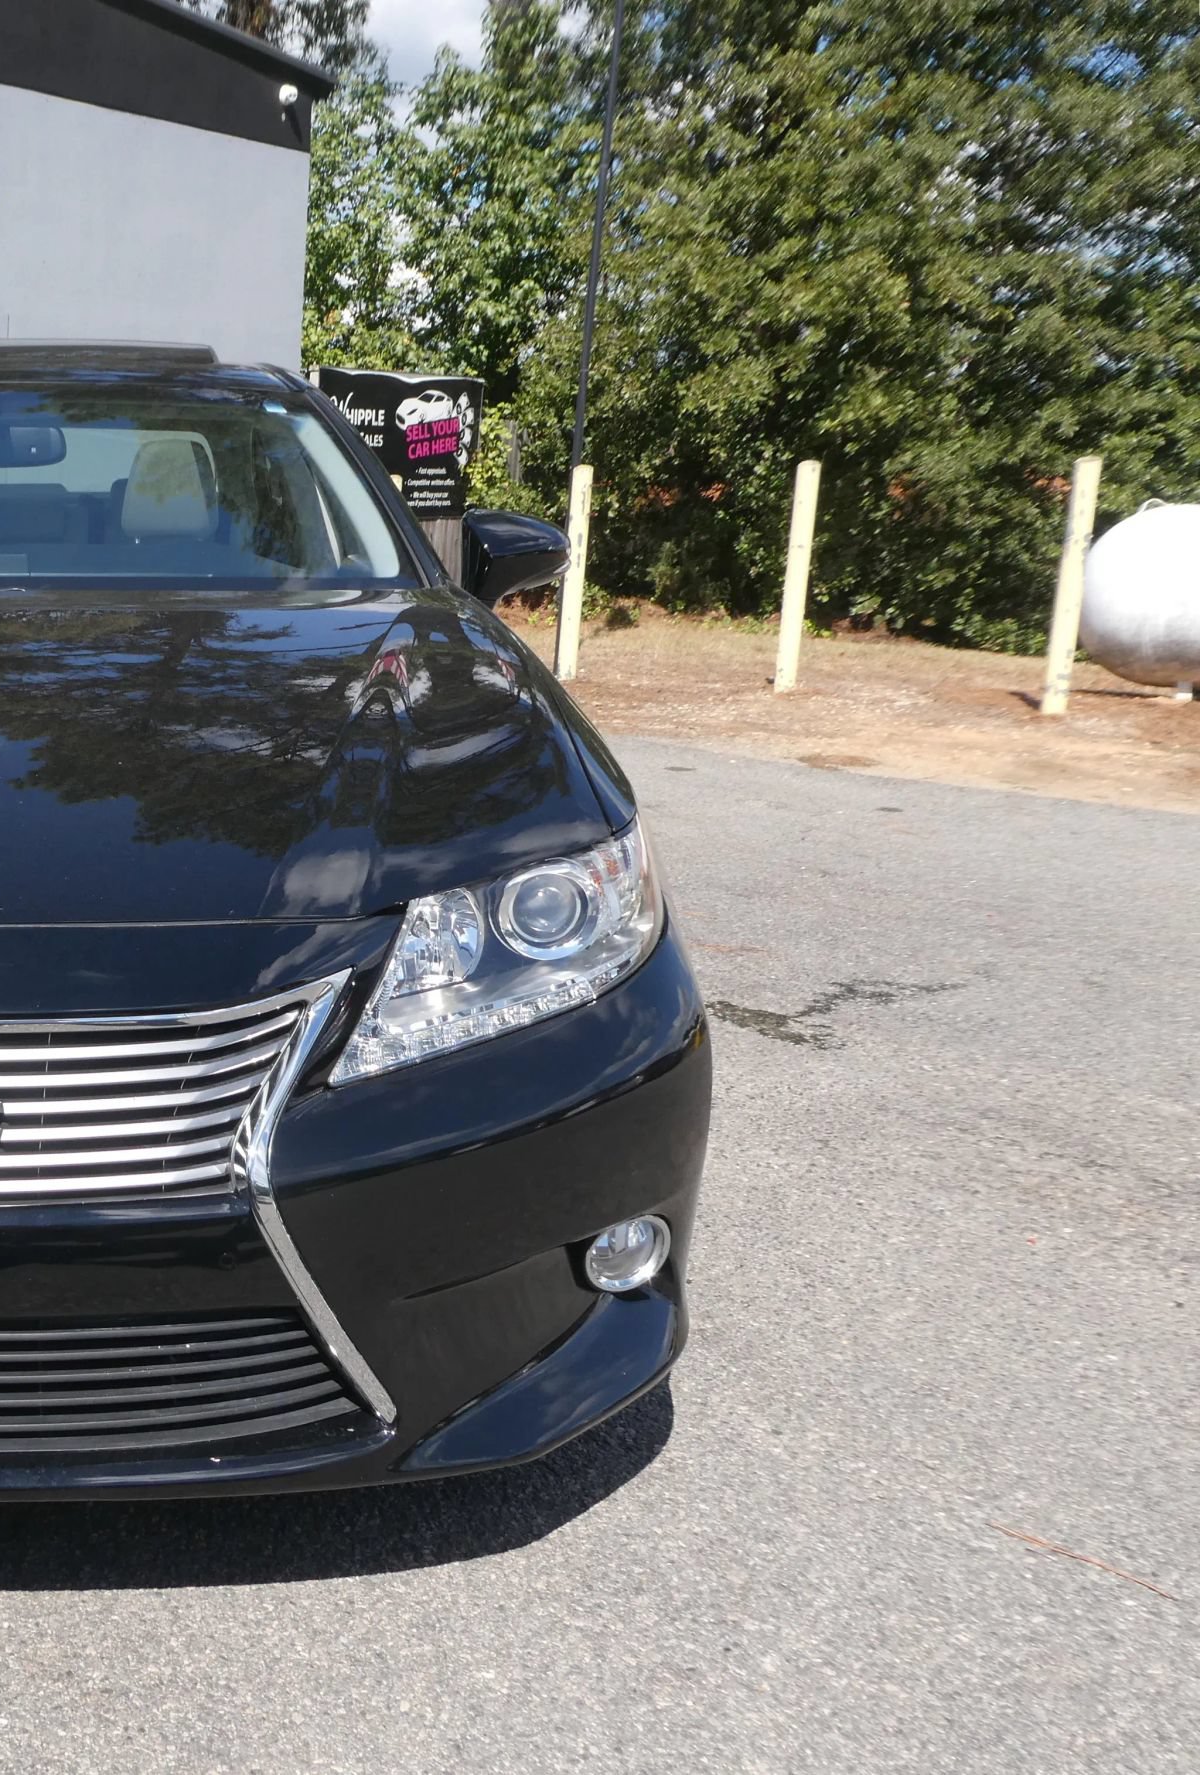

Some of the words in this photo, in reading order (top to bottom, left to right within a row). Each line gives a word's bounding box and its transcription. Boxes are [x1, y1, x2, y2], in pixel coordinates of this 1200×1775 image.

[360, 432, 383, 447] ALES
[406, 423, 431, 442] SELL
[432, 418, 460, 437] YOUR
[408, 441, 430, 459] CAR
[432, 436, 458, 455] HERE
